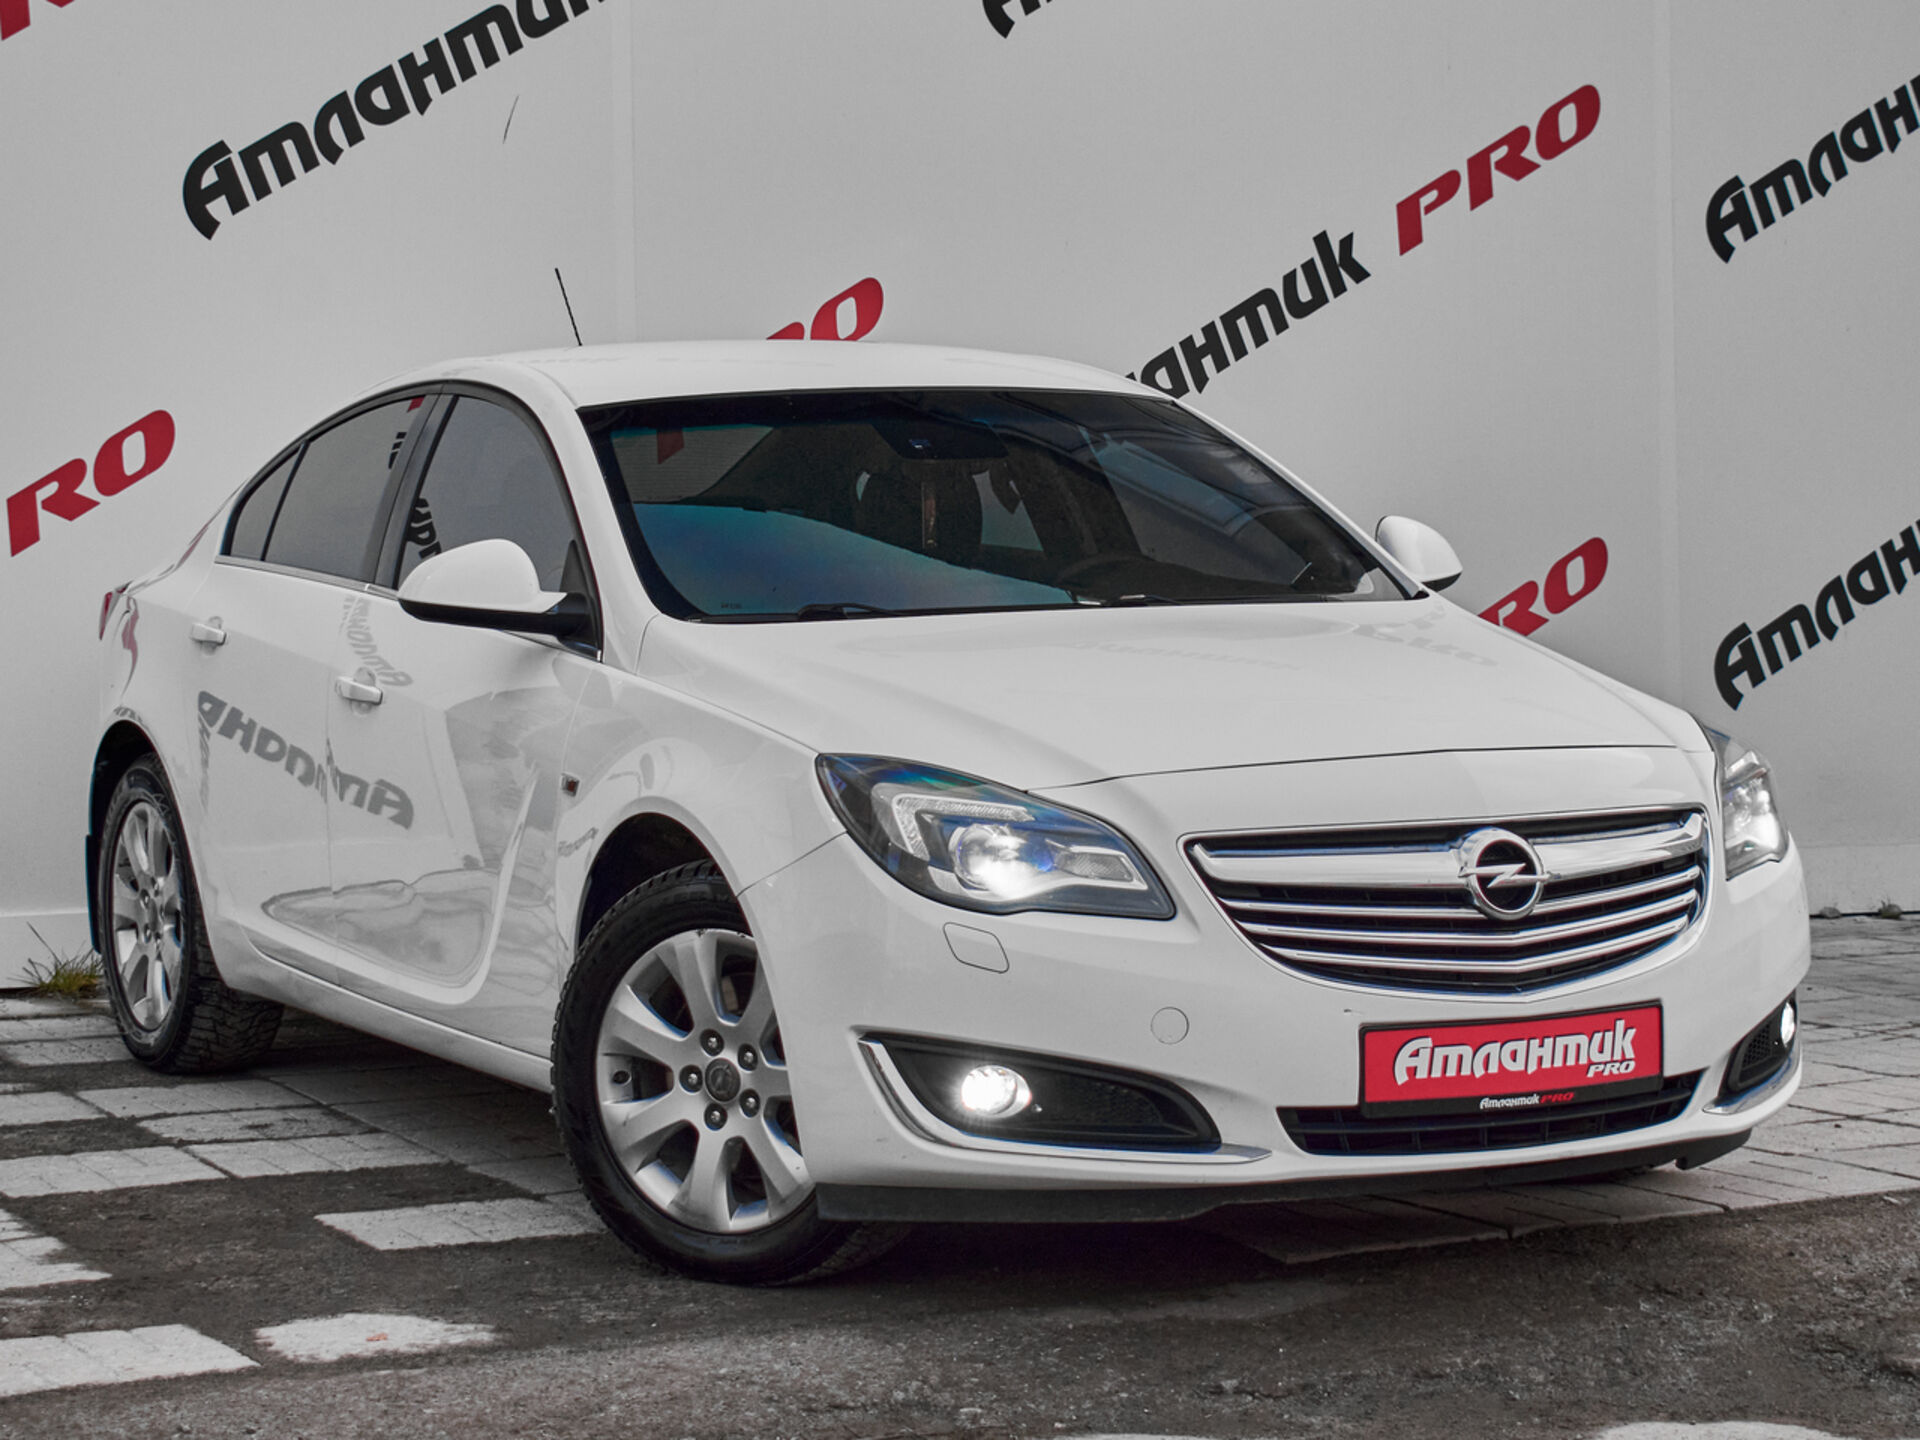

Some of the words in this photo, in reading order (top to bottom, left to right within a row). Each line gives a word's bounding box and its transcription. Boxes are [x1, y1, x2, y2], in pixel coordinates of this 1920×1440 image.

[182, 0, 604, 240] Атланти
[1706, 74, 1920, 264] Атлан
[1125, 230, 1371, 400] антик
[1396, 85, 1601, 256] PRO
[1714, 518, 1920, 711] Атлан
[1394, 1019, 1636, 1086] Атлантик
[1541, 1092, 1575, 1104] PRO
[1586, 1060, 1636, 1078] PRO
